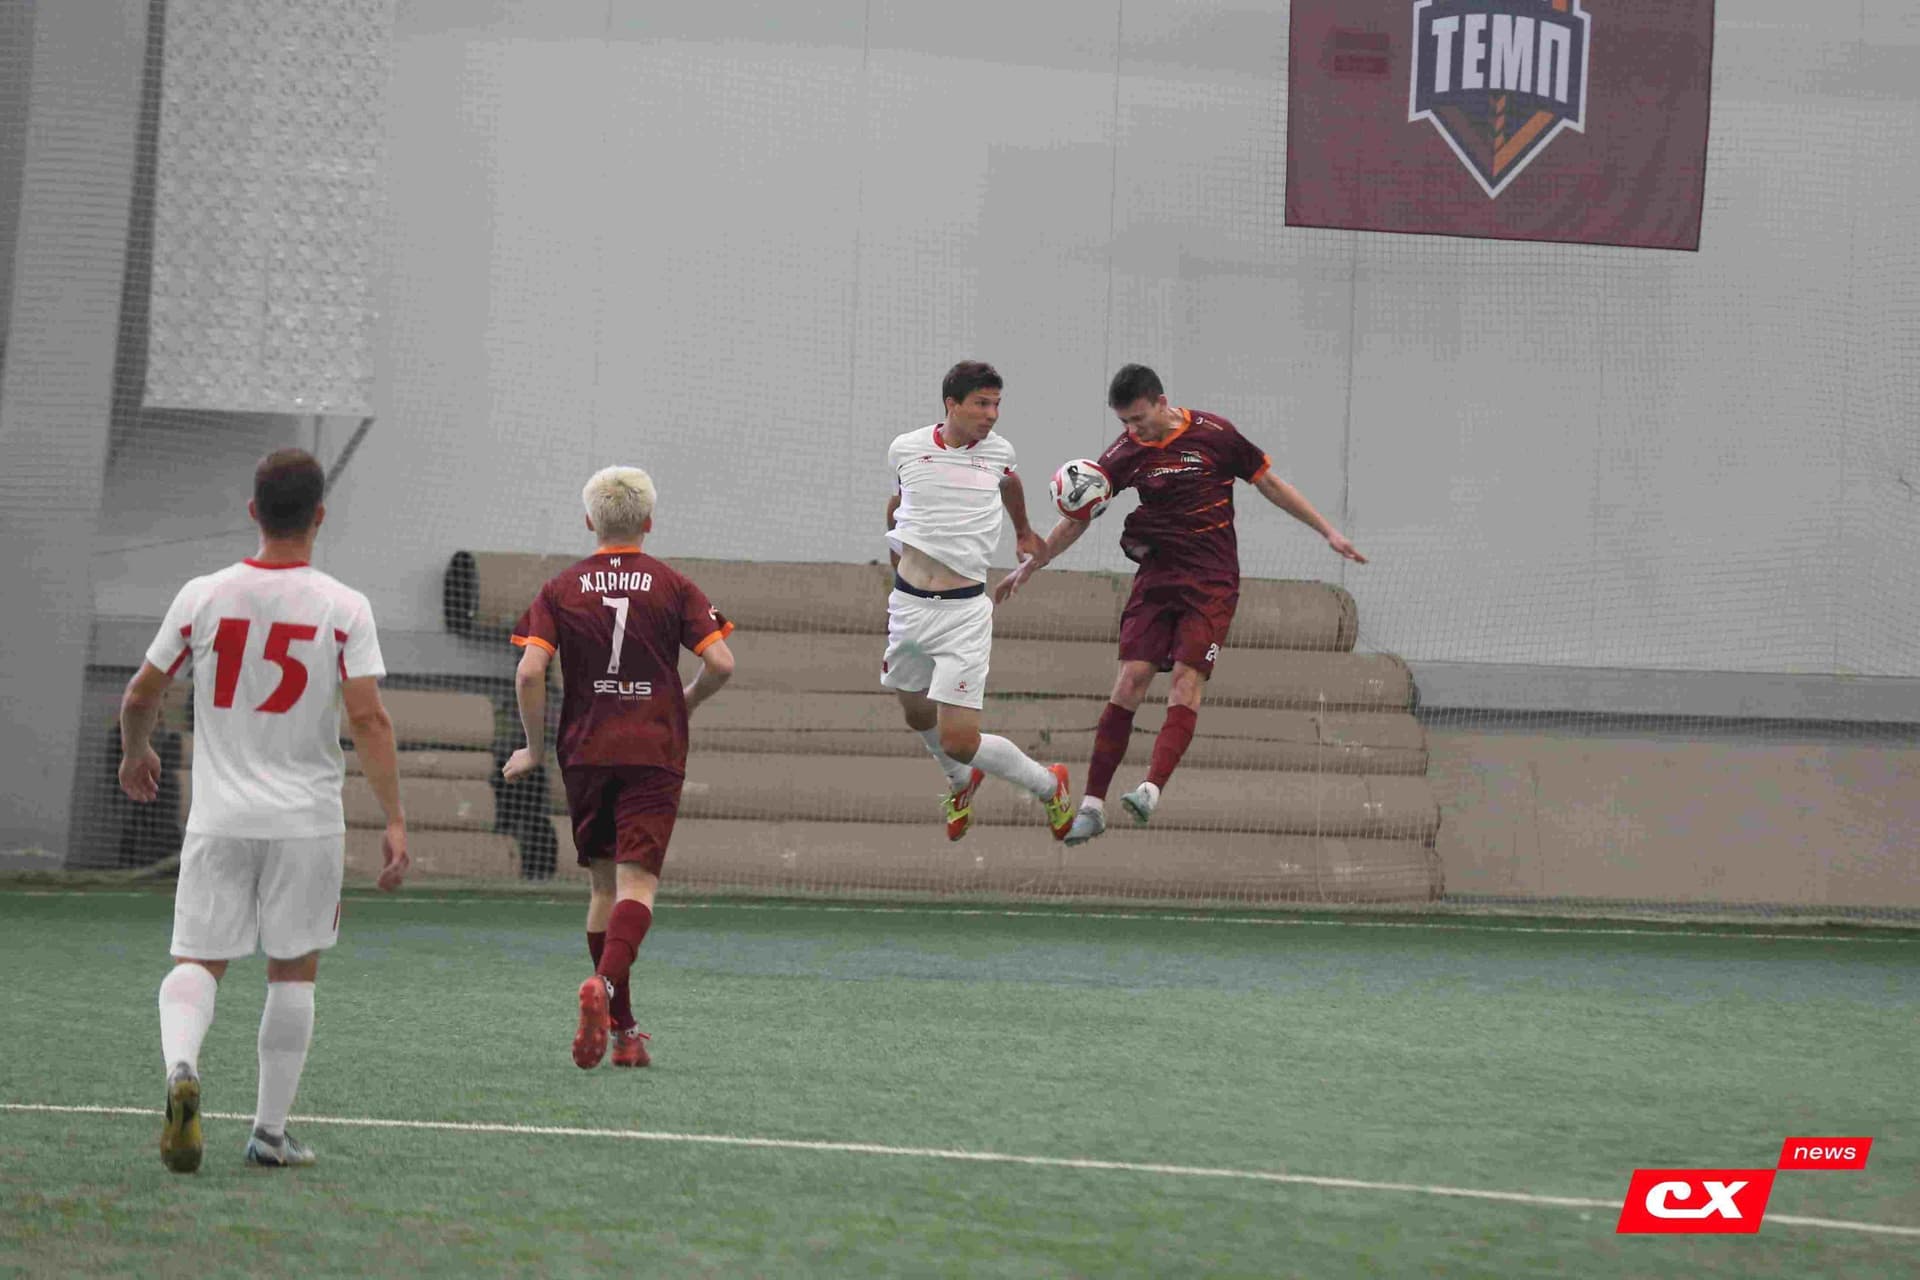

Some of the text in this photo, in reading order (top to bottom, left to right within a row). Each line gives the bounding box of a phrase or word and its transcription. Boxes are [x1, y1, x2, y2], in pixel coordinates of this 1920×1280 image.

[1431, 13, 1571, 104] ТЕМП
[579, 571, 653, 593] ЖДАНОВ
[212, 616, 318, 714] 15
[602, 596, 630, 675] 7
